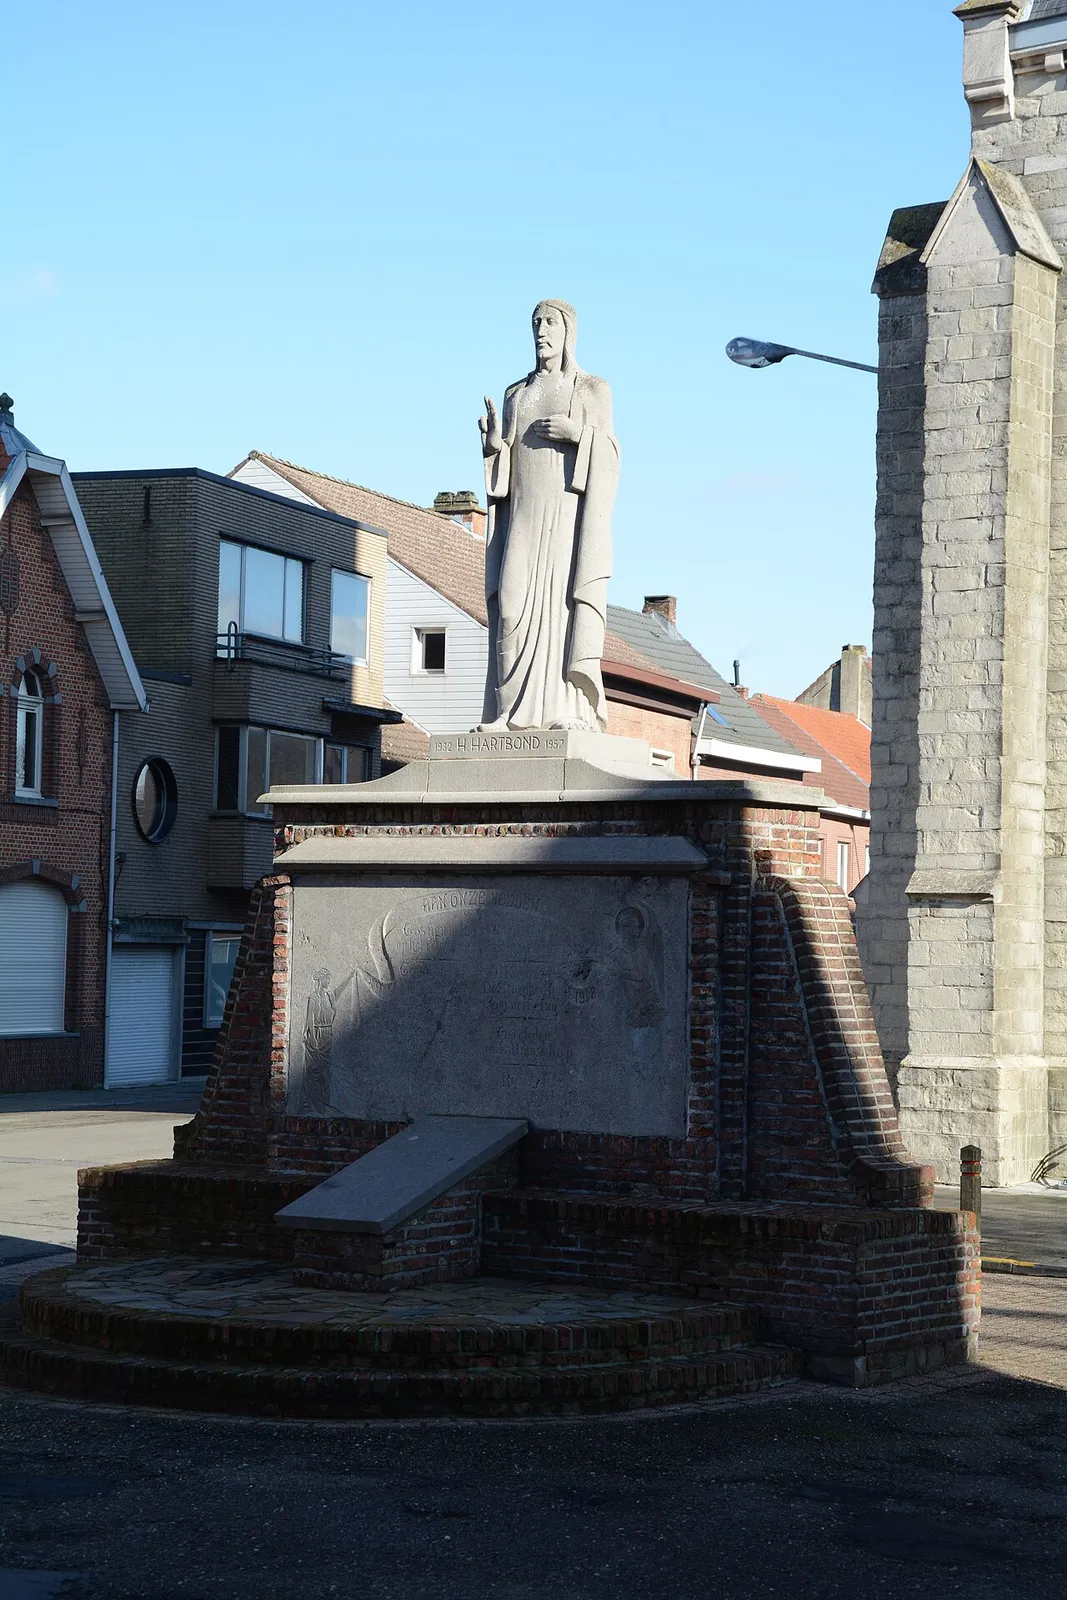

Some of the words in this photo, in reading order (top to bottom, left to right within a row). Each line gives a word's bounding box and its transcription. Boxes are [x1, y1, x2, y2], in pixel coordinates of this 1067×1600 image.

[472, 736, 541, 751] HARTBOND
[544, 739, 565, 750] 1957
[451, 891, 486, 908] ONZE
